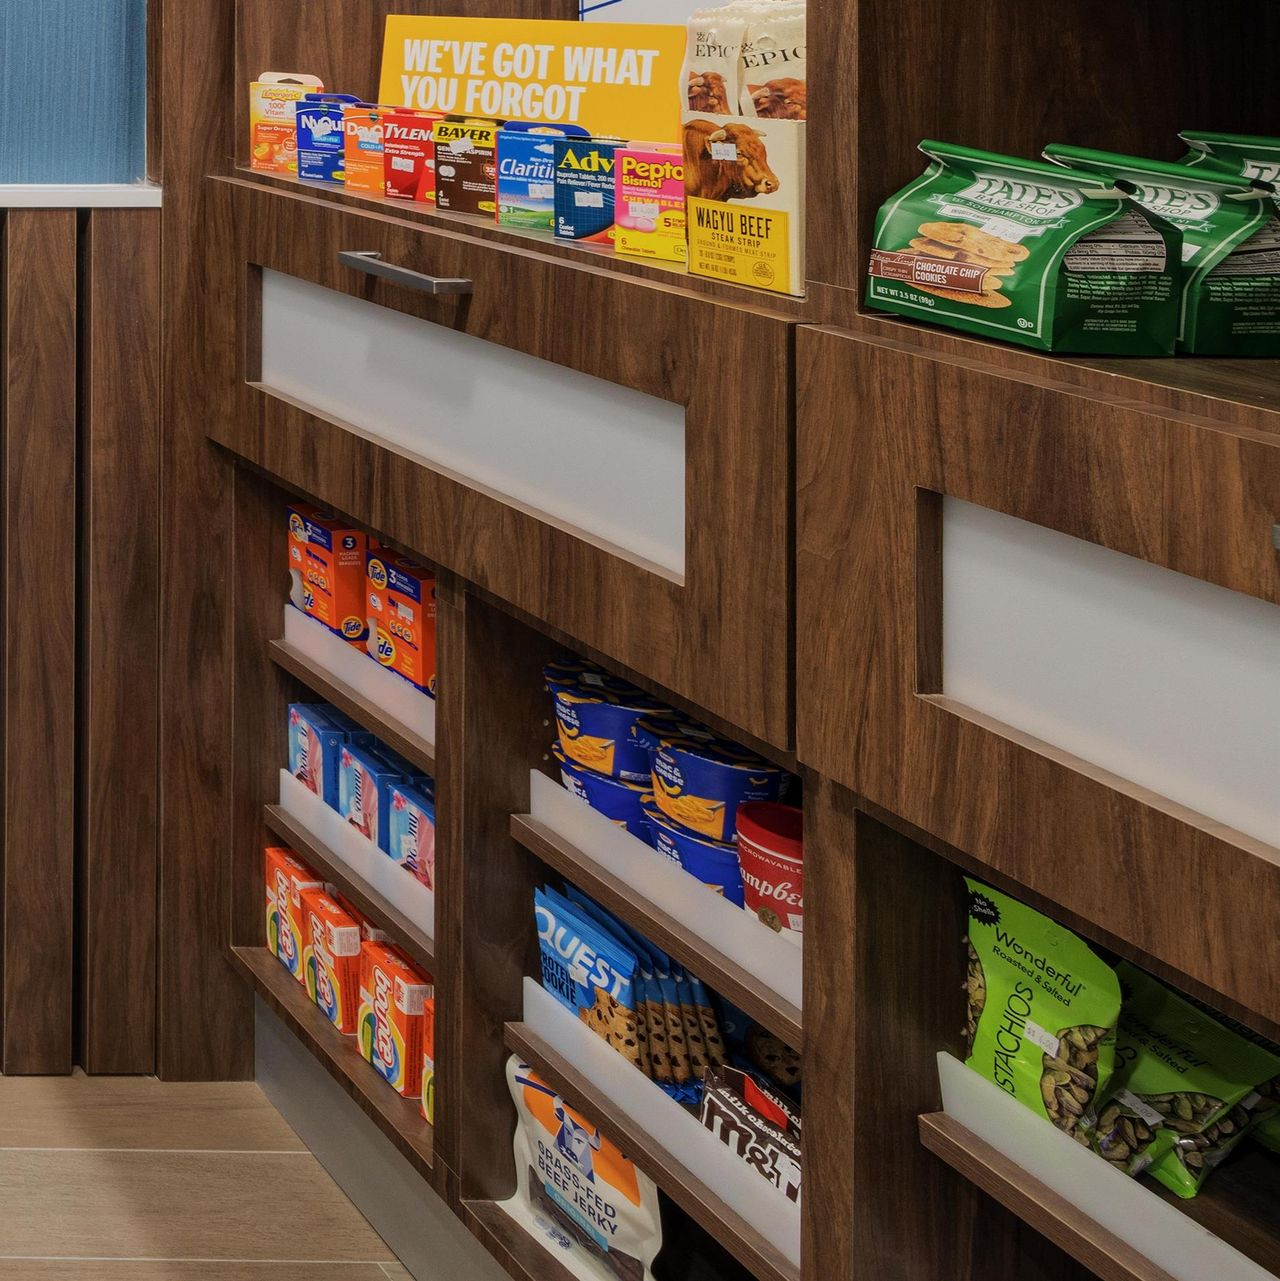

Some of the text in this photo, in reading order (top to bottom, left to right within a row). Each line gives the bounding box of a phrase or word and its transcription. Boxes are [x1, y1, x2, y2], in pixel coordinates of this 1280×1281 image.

[403, 38, 660, 86] WE'VE GOT WHAT
[400, 74, 587, 122] YOU FORGOT
[257, 124, 294, 134] Super Orange
[437, 126, 491, 142] BAYER
[400, 150, 426, 158] Strength
[466, 148, 493, 157] ASPIRIN
[556, 171, 607, 182] Ibuprofen 200
[622, 156, 685, 182] Pepto
[556, 177, 567, 185] Pain
[622, 176, 662, 189] Bismol
[978, 176, 1076, 209] TATE'S
[975, 193, 1057, 217] BAKE SHOP
[1149, 204, 1192, 216] SHOP
[558, 216, 565, 225] 6
[663, 216, 672, 228] 5
[696, 206, 773, 239] WAGYU BEEF
[711, 231, 761, 249] STEAK STRIP
[915, 260, 981, 279] CHOCOLATE CHIP
[915, 271, 948, 285] COOKIES
[876, 285, 890, 295] NET
[889, 287, 898, 297] WT
[898, 289, 910, 299] 3.5
[344, 537, 354, 548] 3
[369, 565, 386, 582] Tide
[388, 569, 398, 584] 3
[343, 621, 362, 634] Tide
[555, 702, 571, 716] mac
[556, 709, 581, 727] cheese
[655, 756, 672, 775] mac
[655, 764, 684, 786] cheese
[657, 839, 672, 857] mac
[972, 904, 996, 918] Shells
[974, 897, 988, 908] No
[275, 868, 296, 960] bounce
[308, 911, 333, 1008] bounce
[535, 906, 631, 998] QUEST
[994, 926, 1083, 998] Wonderful
[992, 944, 1035, 979] Roasted
[1040, 978, 1072, 1009] Salted
[372, 964, 395, 1068] bounce
[1150, 1043, 1189, 1075] Salted
[716, 1086, 802, 1157] milk chocolate
[538, 1140, 617, 1219] GRASS-FED
[538, 1154, 619, 1236] BEEF JERKY
